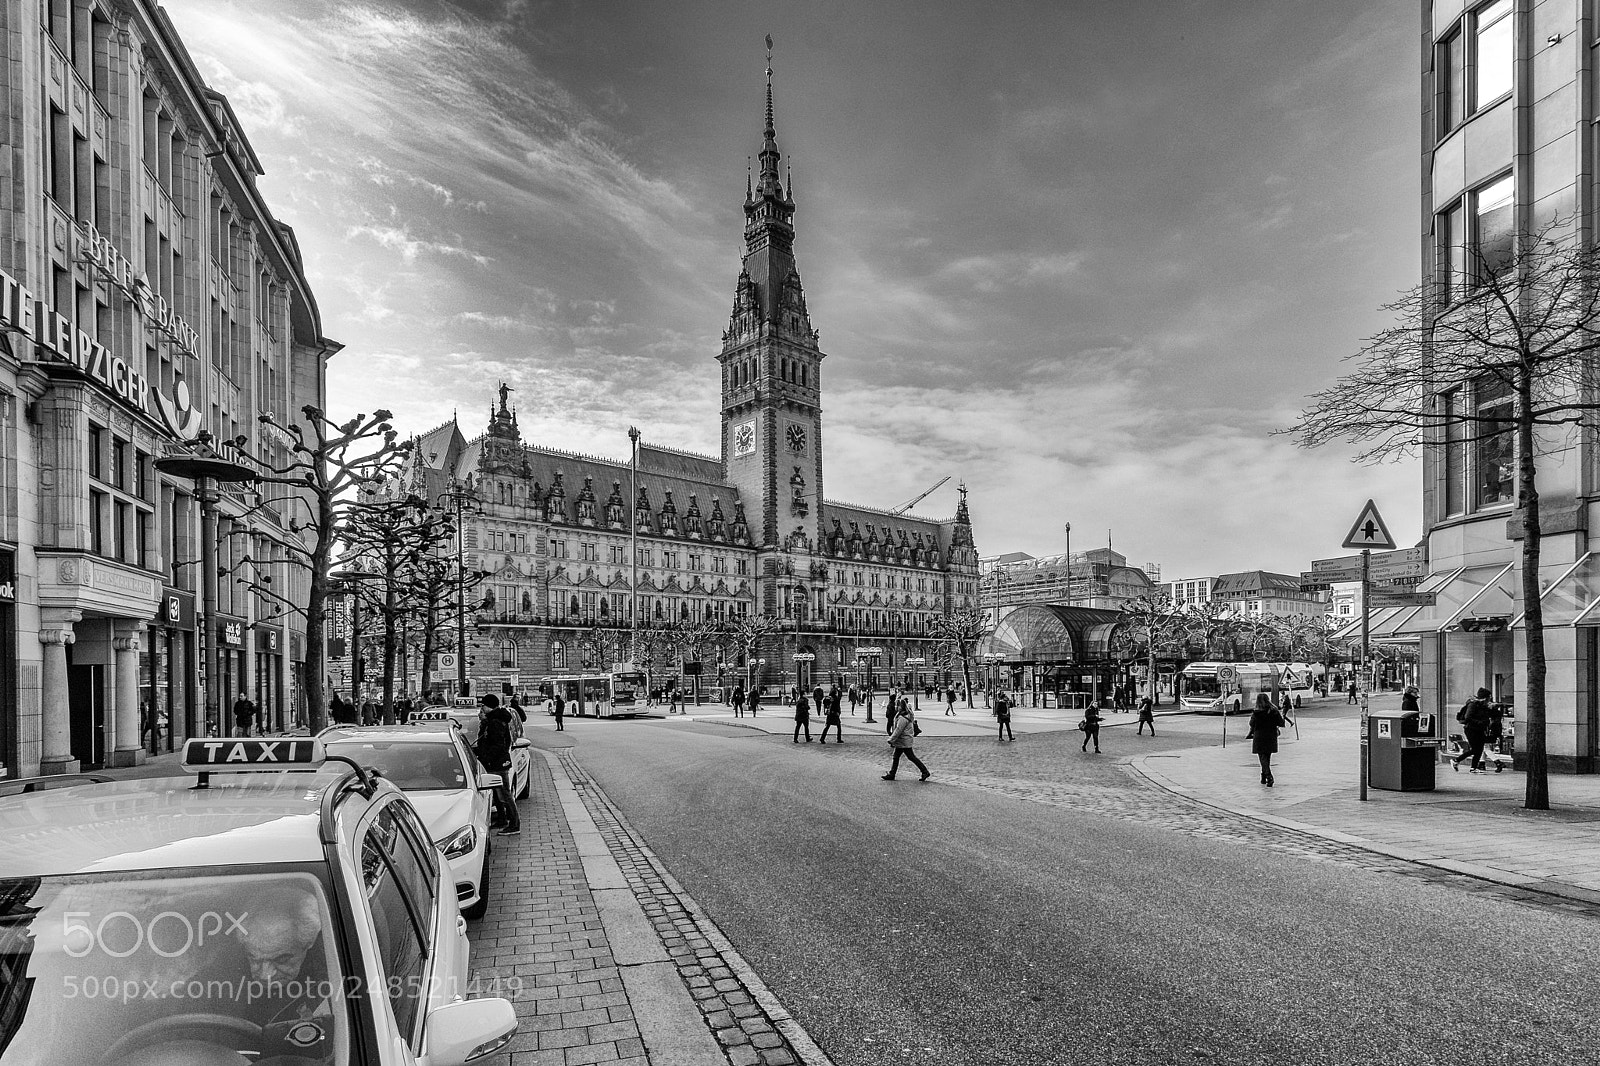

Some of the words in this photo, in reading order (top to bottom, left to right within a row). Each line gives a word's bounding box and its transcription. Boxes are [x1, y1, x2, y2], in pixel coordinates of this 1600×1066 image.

[153, 294, 199, 360] BANK
[36, 301, 150, 414] LEIPZIGER
[0, 581, 14, 598] ok
[336, 601, 344, 639] HIRMER
[1223, 670, 1232, 678] 20
[414, 712, 442, 720] TAXI
[203, 741, 297, 763] TAXI
